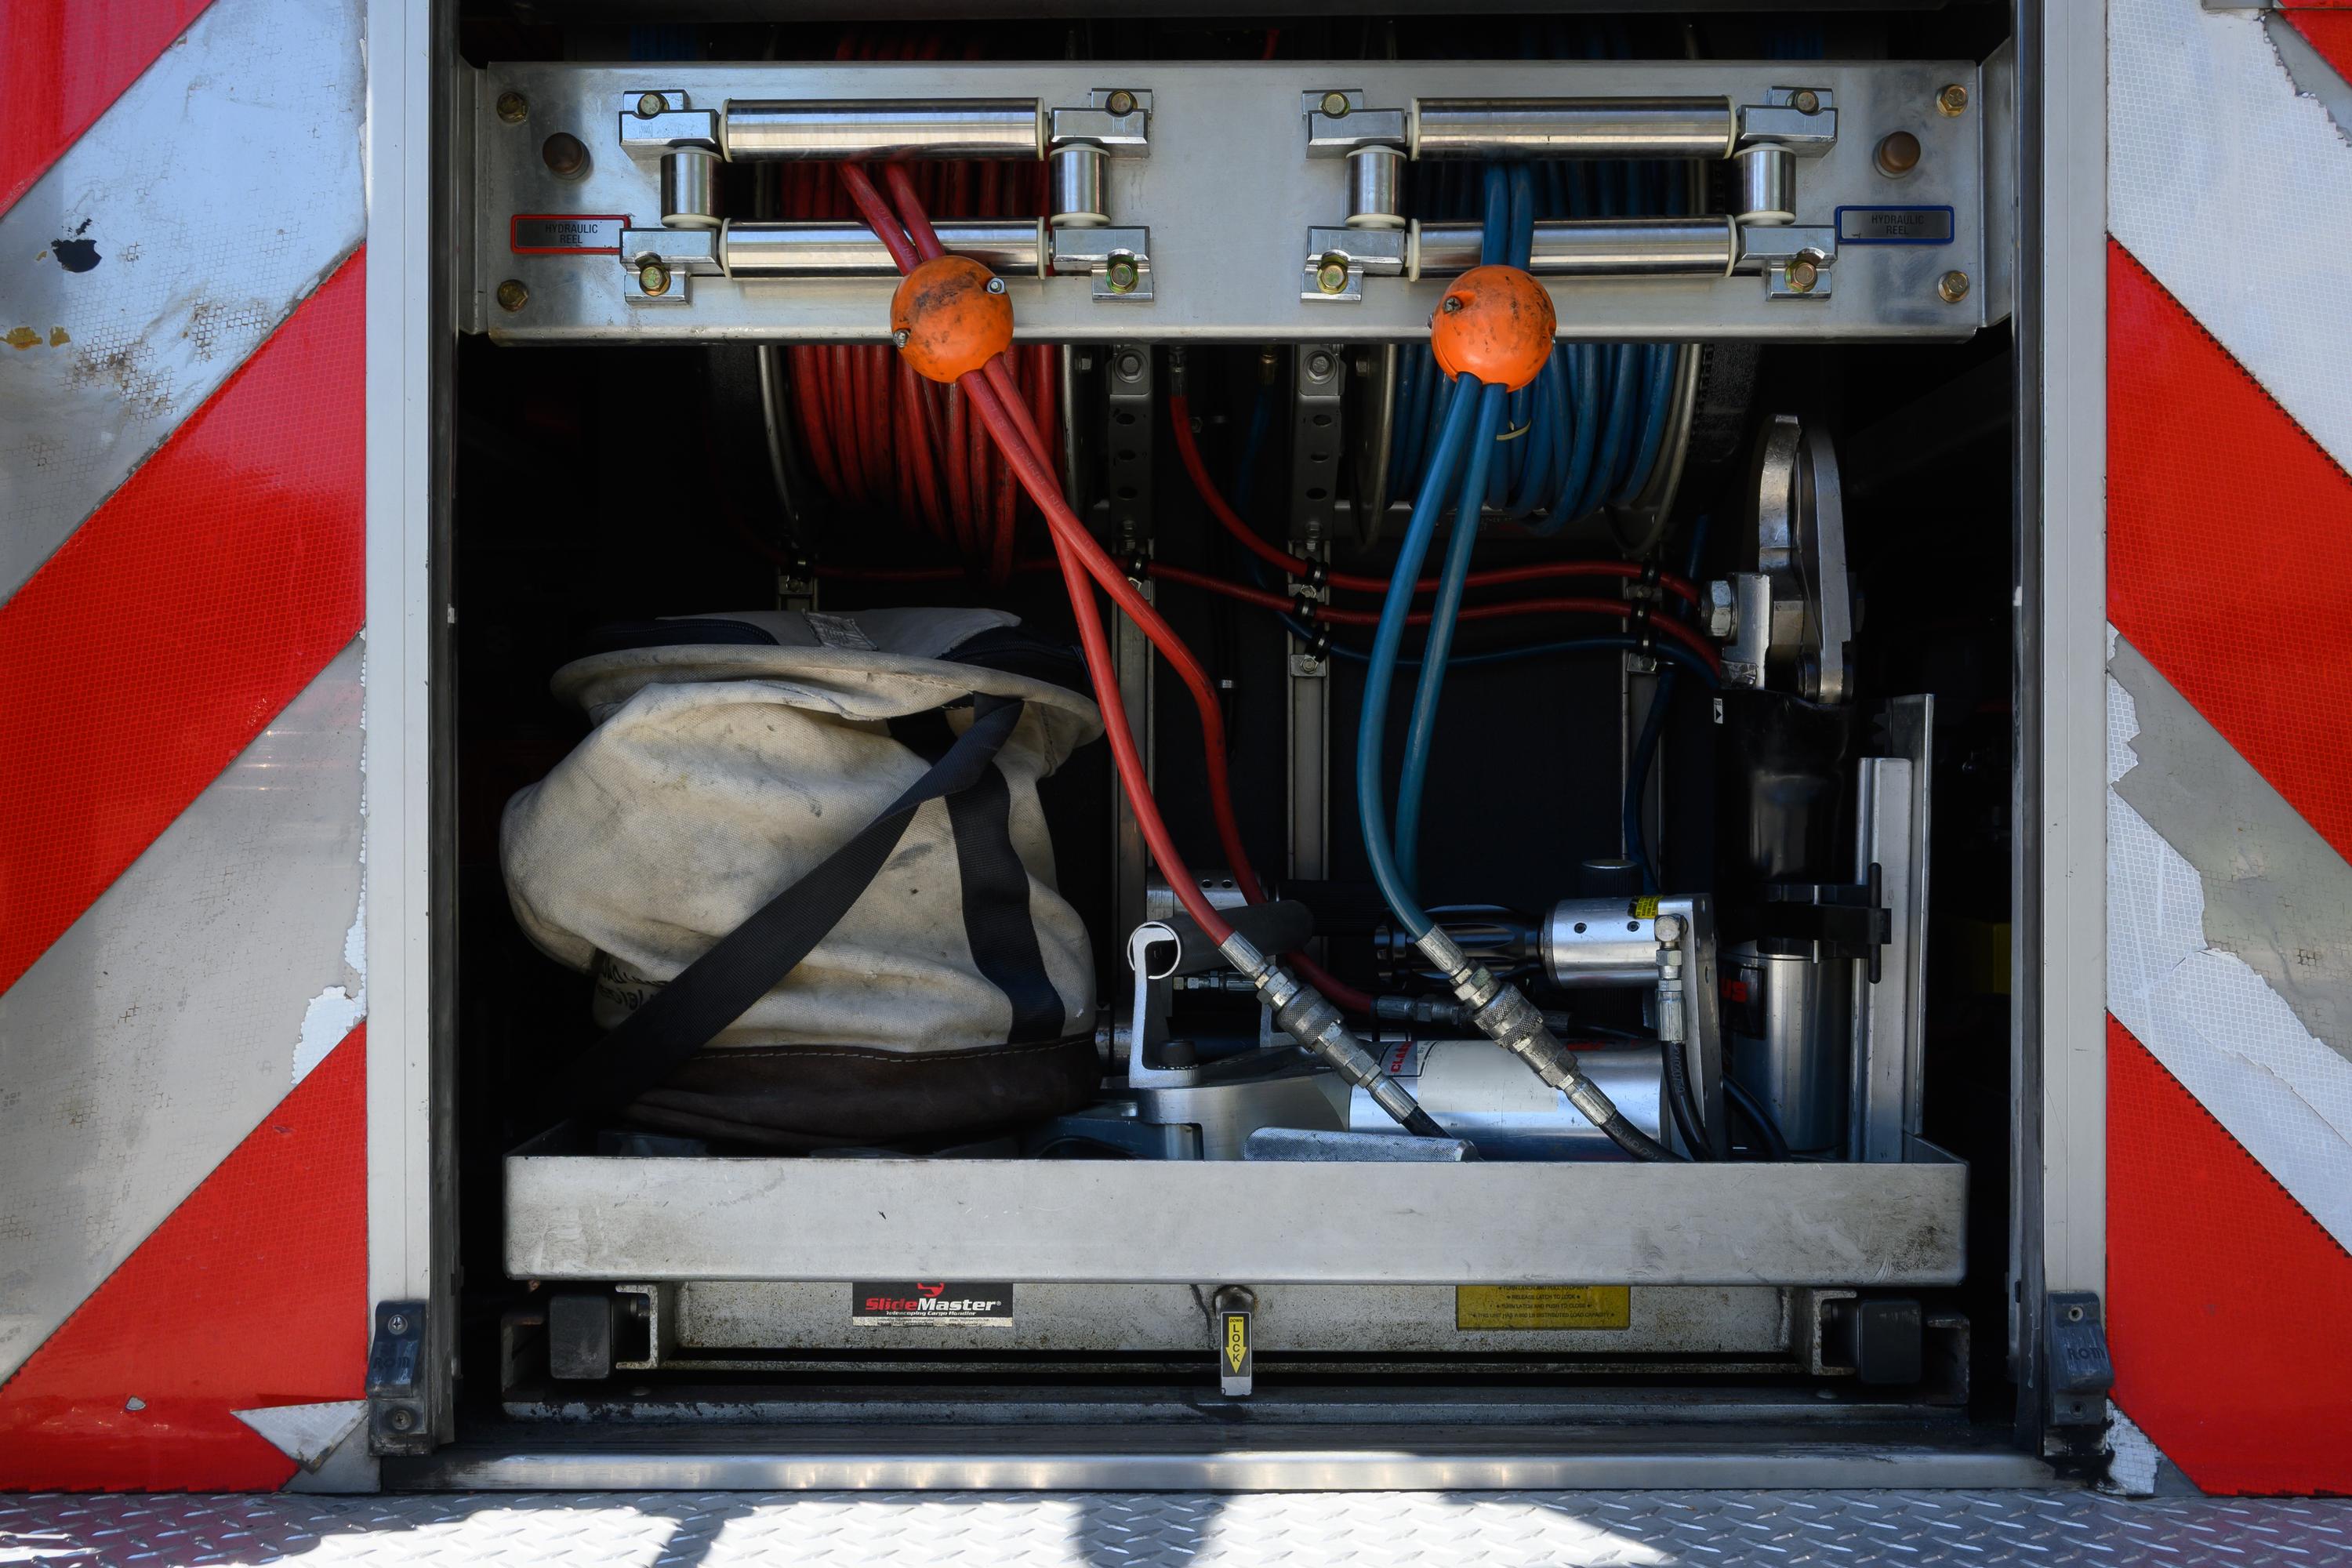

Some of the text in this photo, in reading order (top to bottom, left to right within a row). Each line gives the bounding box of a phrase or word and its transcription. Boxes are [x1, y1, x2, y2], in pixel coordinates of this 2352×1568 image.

[1871, 215, 1925, 224] HYDRAULIC
[545, 223, 598, 234] HYDRAULIC
[1886, 225, 1909, 235] REEL
[559, 234, 583, 244] REEL
[1232, 1324, 1240, 1363] LOCK
